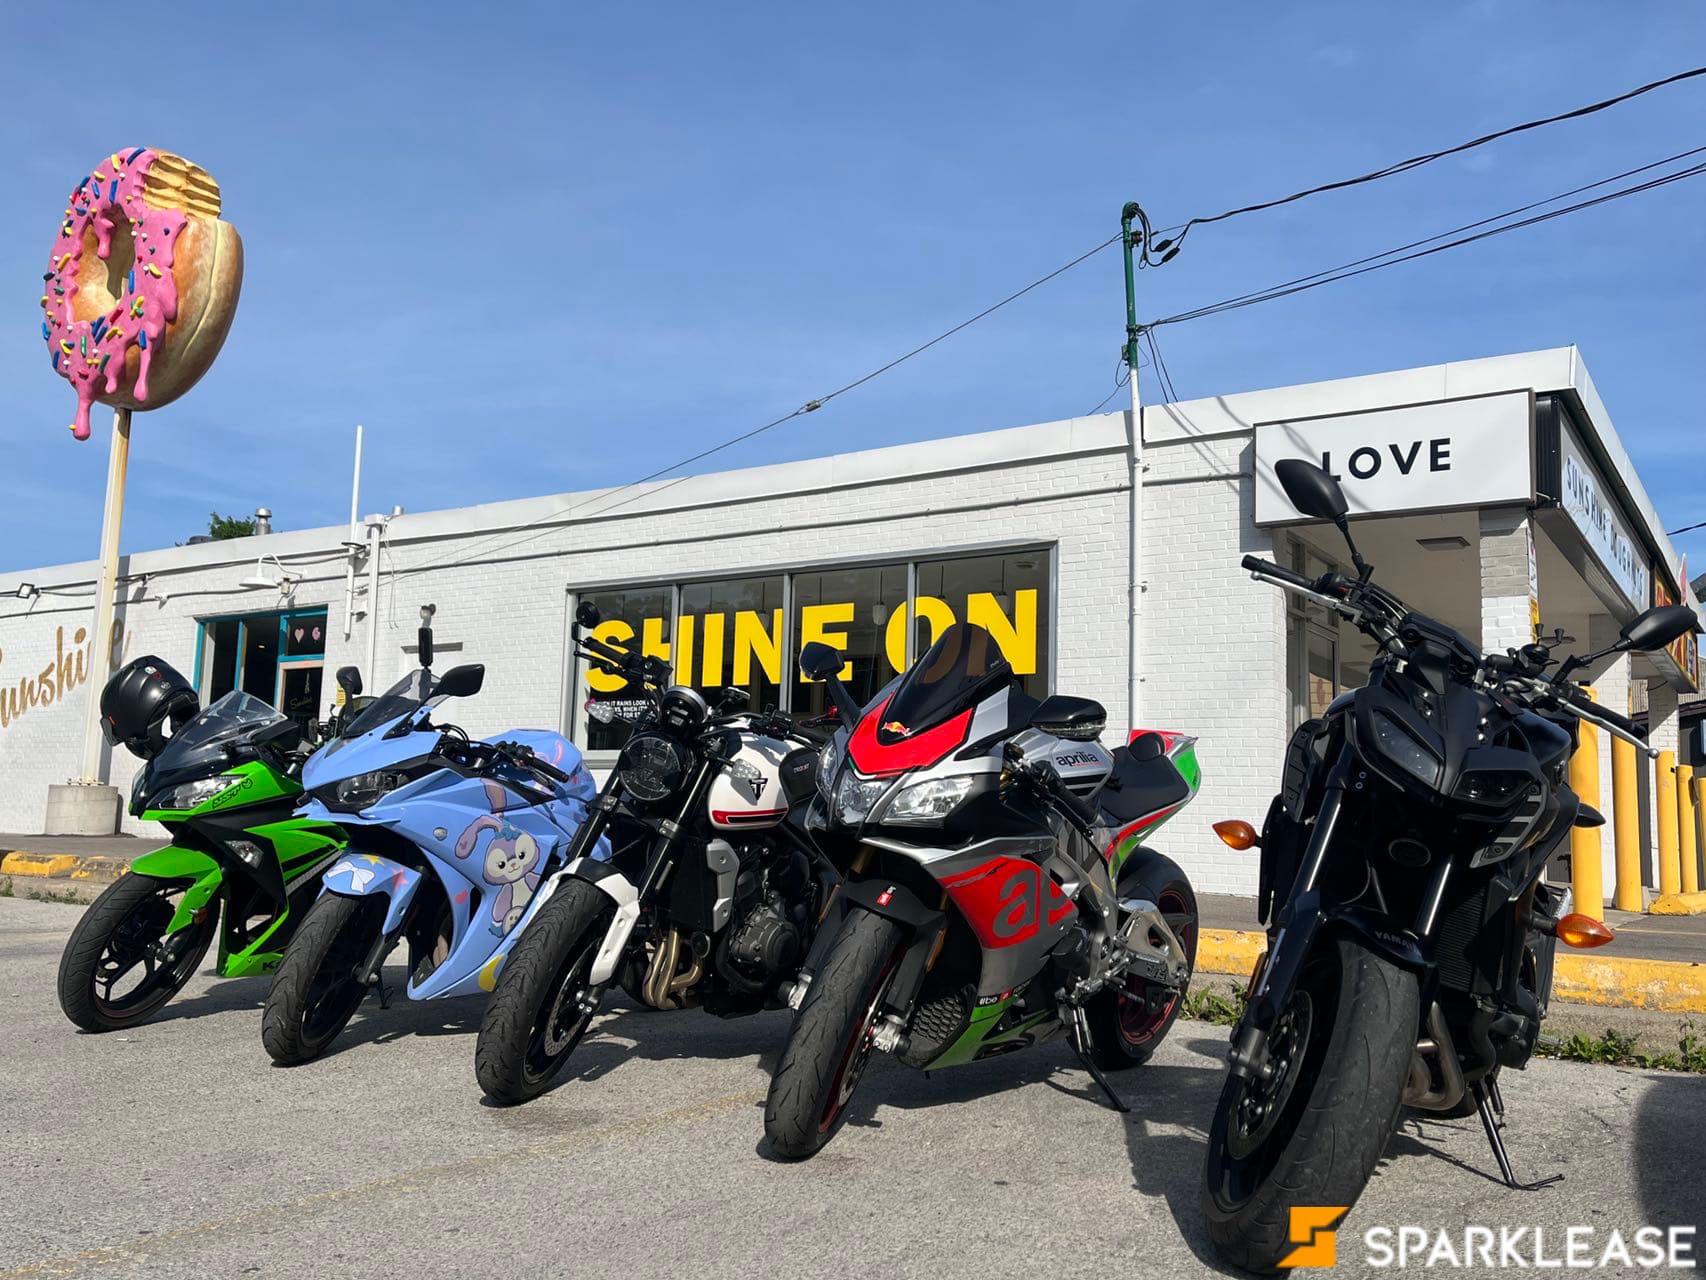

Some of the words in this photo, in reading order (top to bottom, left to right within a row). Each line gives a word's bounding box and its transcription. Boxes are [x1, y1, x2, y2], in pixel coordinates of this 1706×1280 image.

[1321, 437, 1451, 482] LOVE
[1566, 456, 1608, 543] SUNSHINE
[0, 618, 131, 728] unshie
[585, 602, 855, 693] SHINE
[885, 589, 1038, 684] ON
[1055, 751, 1099, 767] aprilia
